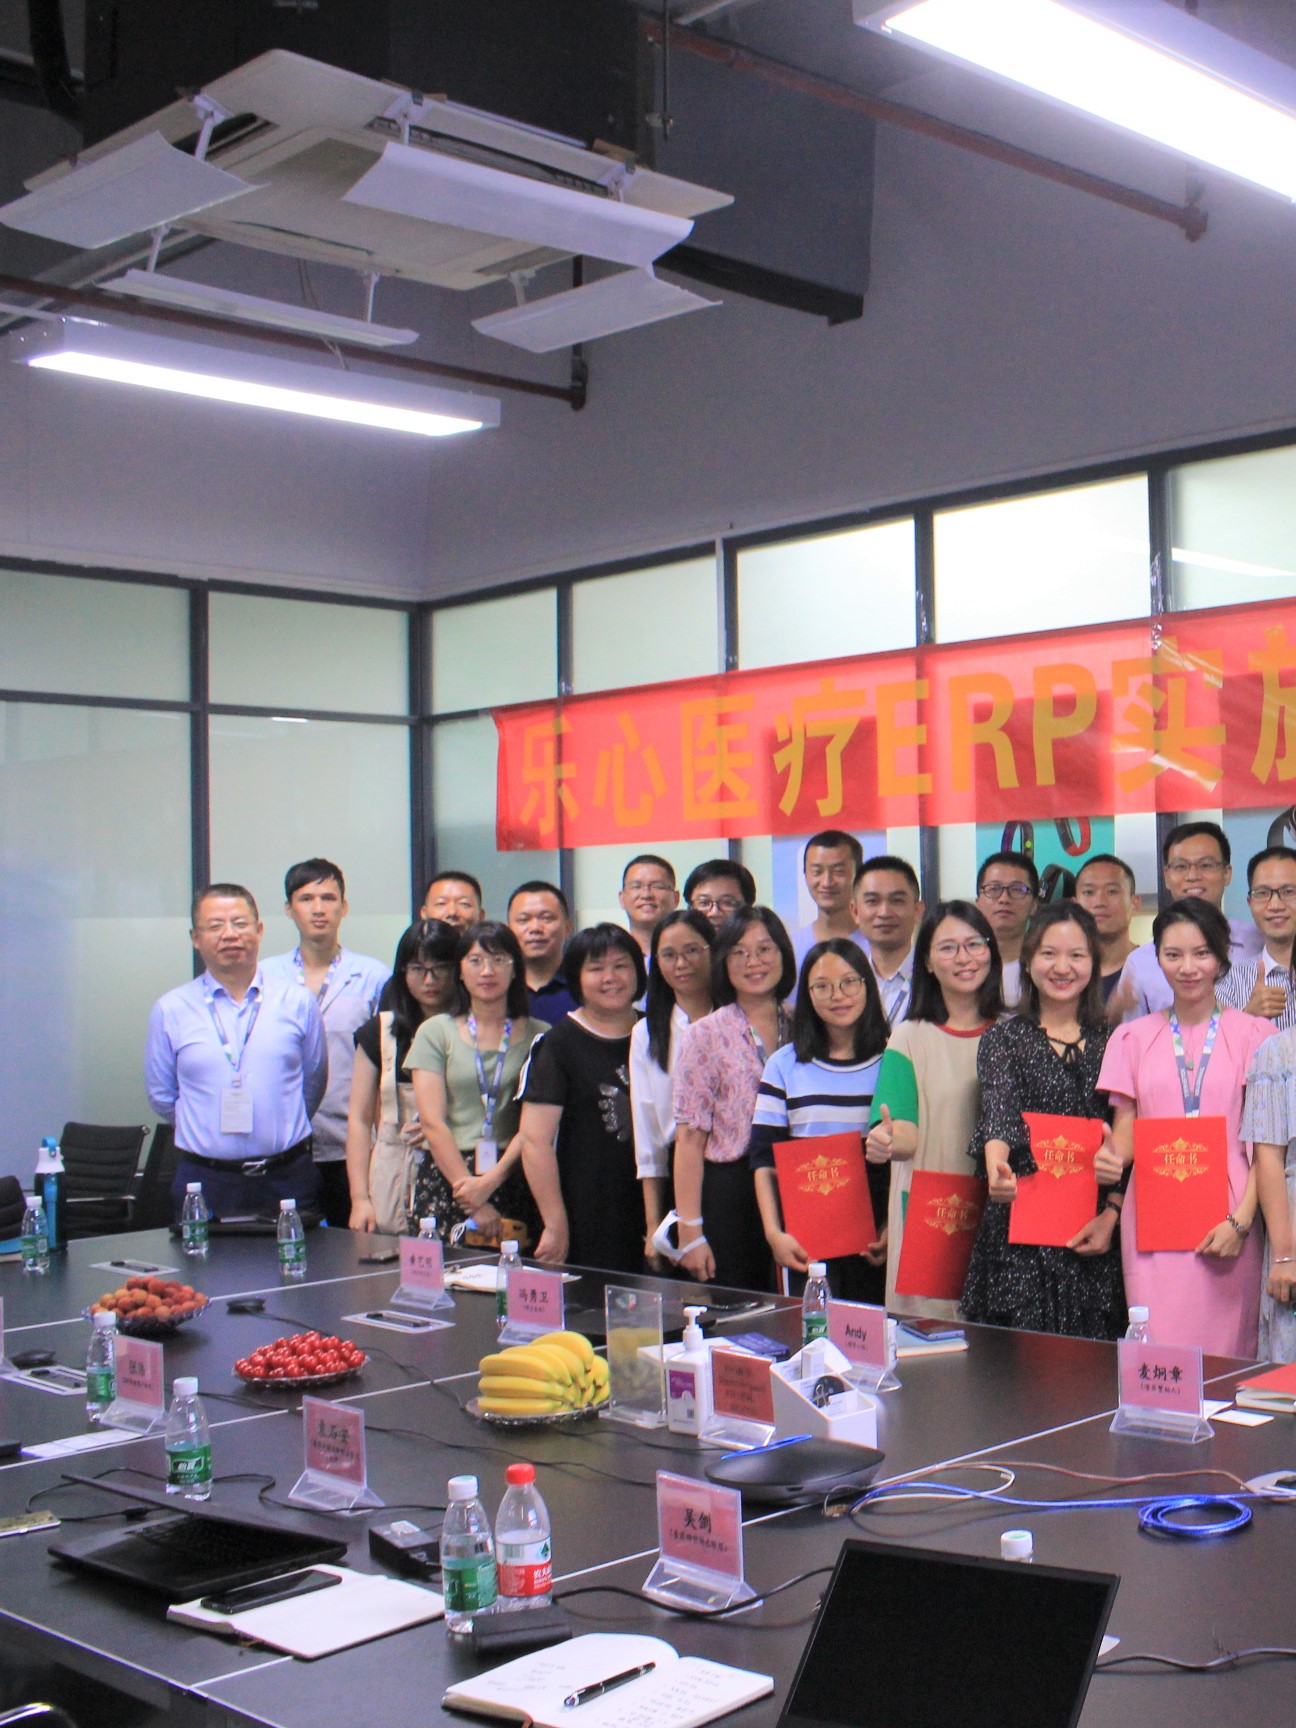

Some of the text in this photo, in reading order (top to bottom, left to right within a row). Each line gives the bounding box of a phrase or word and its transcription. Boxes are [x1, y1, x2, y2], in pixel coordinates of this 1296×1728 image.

[1044, 1149, 1075, 1163] 任命书
[1164, 1153, 1198, 1165] 任命书
[807, 1167, 840, 1182] 任命书
[936, 1207, 969, 1220] 任命书
[845, 1324, 867, 1342] Andy
